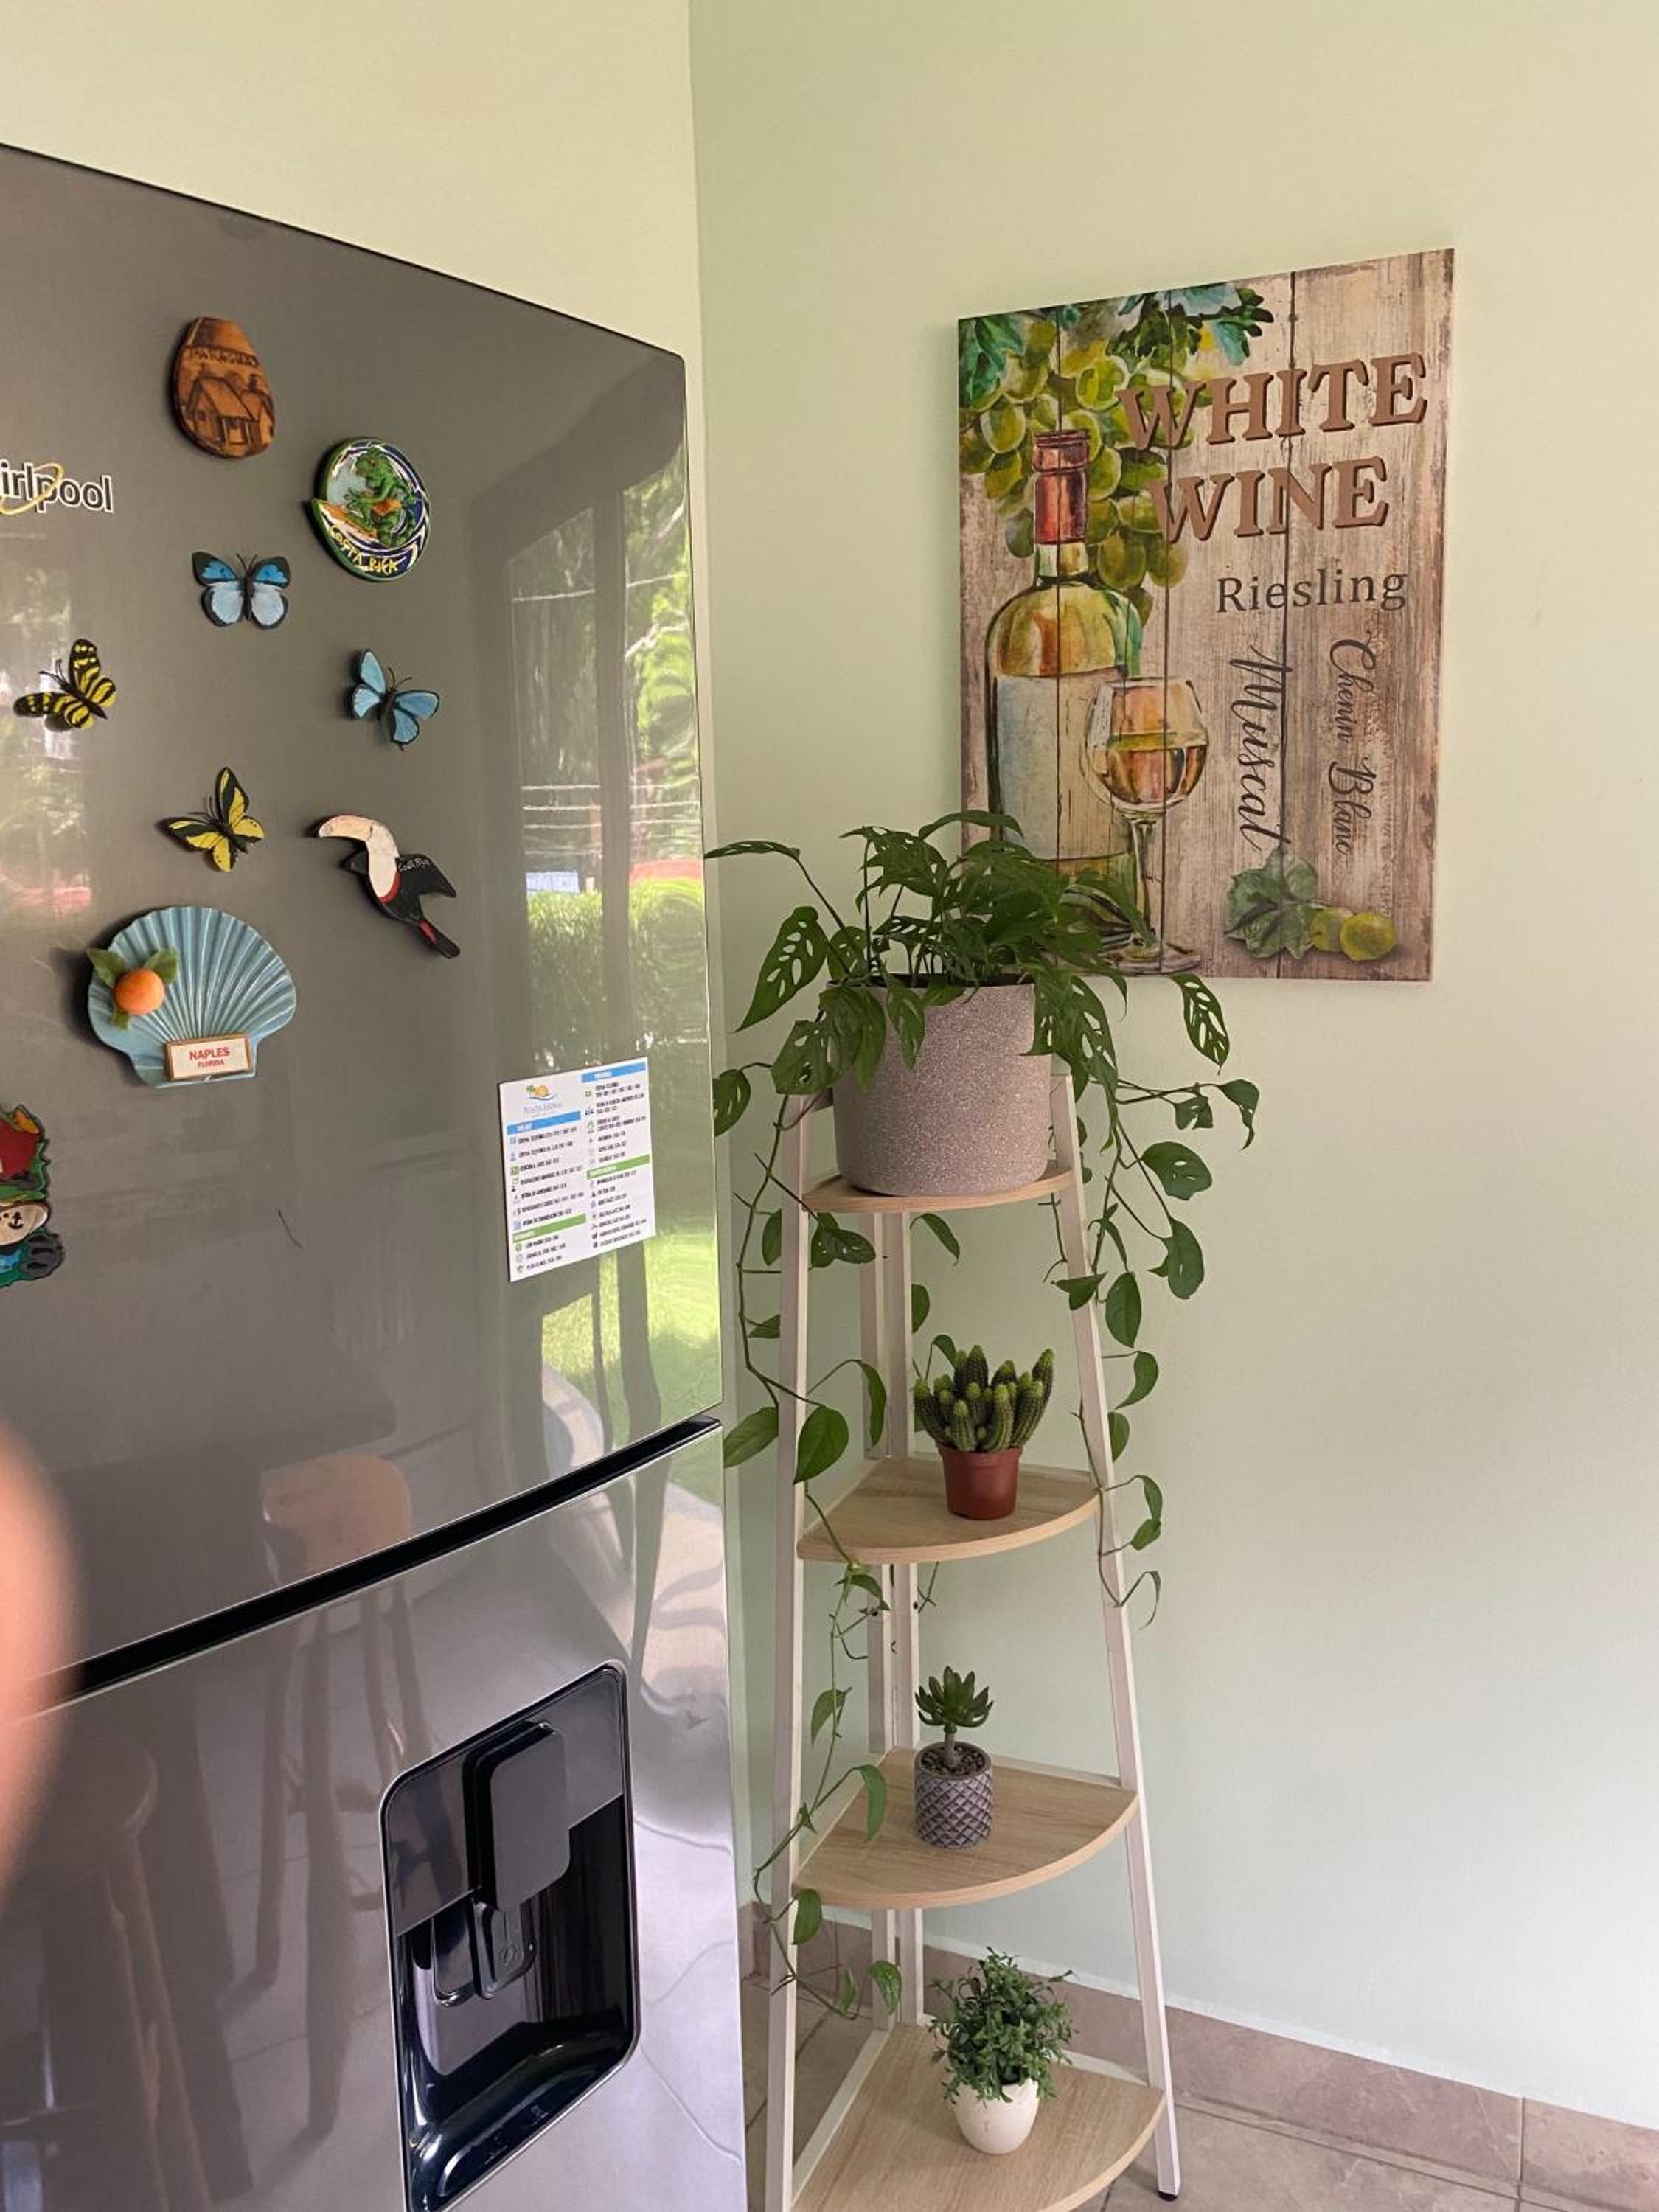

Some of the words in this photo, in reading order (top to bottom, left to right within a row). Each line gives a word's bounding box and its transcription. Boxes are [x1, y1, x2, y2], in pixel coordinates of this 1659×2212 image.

[1115, 354, 1429, 451] WHITE
[0, 459, 114, 514] irlpool
[1148, 456, 1390, 544] WINE
[1216, 568, 1408, 613] Riesling
[1330, 630, 1377, 744] Chenin
[1229, 645, 1293, 851] Muscat
[1329, 757, 1377, 855] Blanc
[189, 1047, 230, 1060] NAPLES
